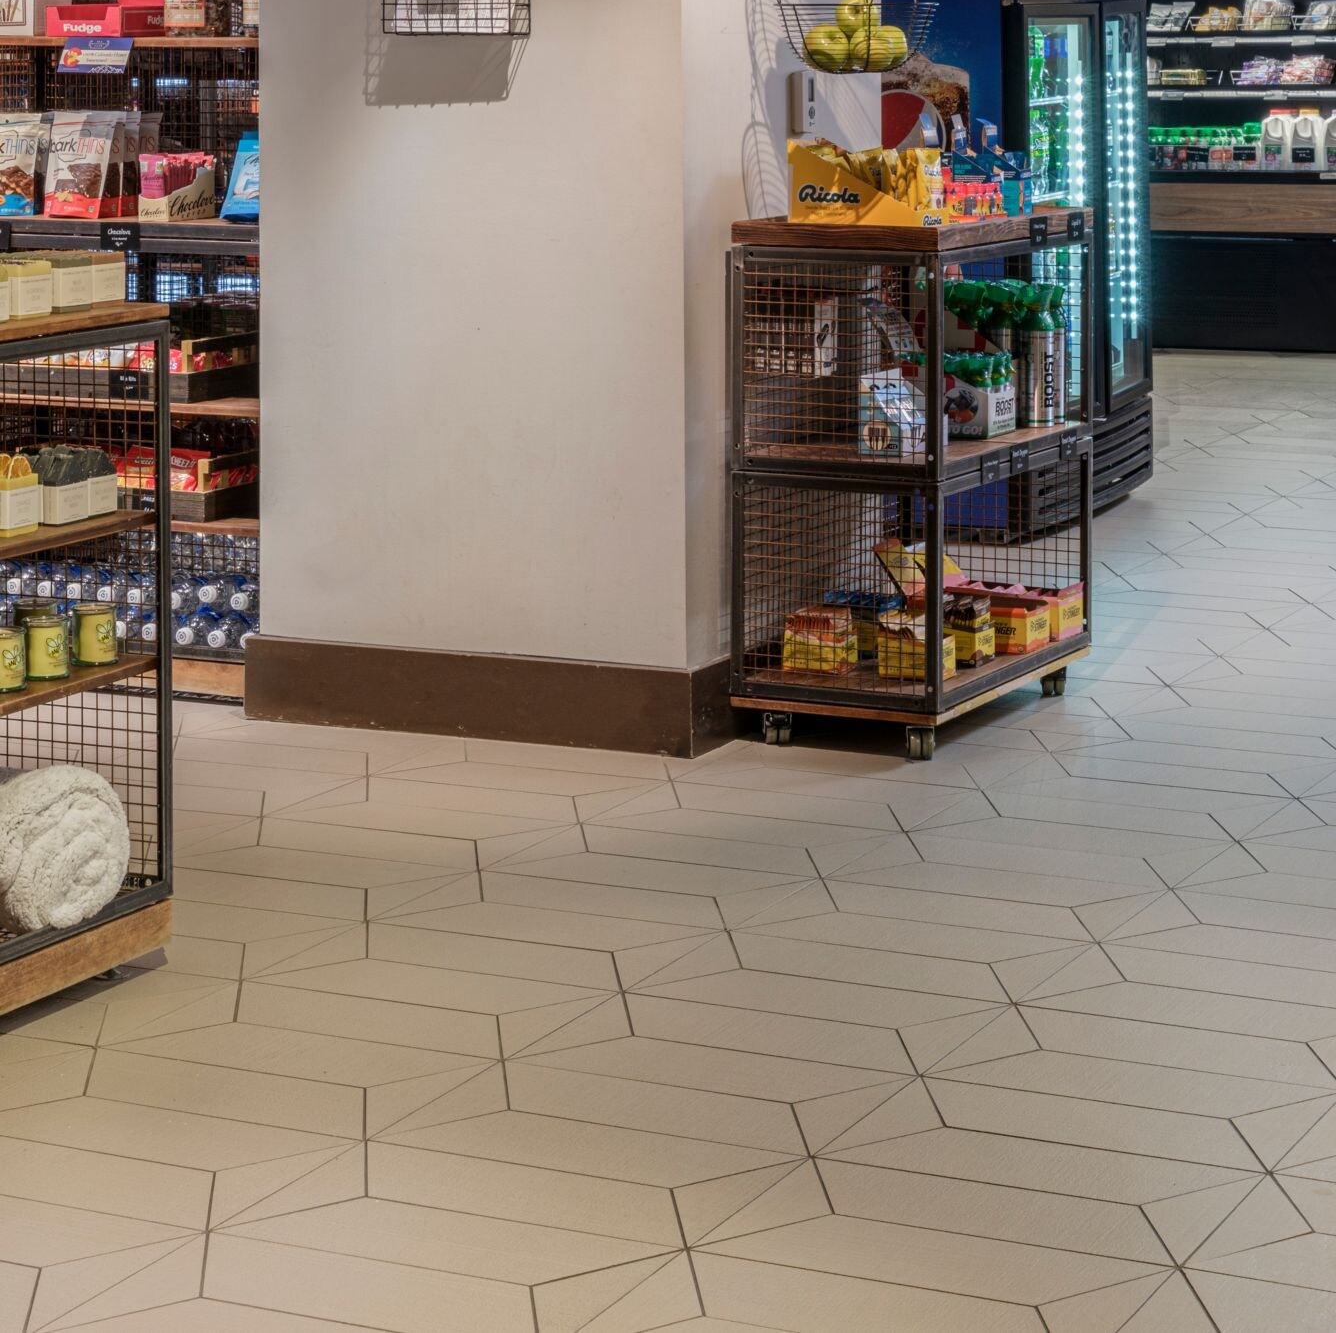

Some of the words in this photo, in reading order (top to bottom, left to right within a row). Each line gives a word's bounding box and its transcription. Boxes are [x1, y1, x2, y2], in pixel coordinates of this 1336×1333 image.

[63, 23, 102, 34] Fudge
[799, 184, 861, 203] Ricola
[170, 190, 214, 217] Chocolove
[923, 215, 942, 226] Ricola
[1045, 352, 1054, 407] BOOST
[995, 398, 1014, 411] BOOST
[962, 425, 983, 435] GO!
[996, 626, 1016, 636] NGER
